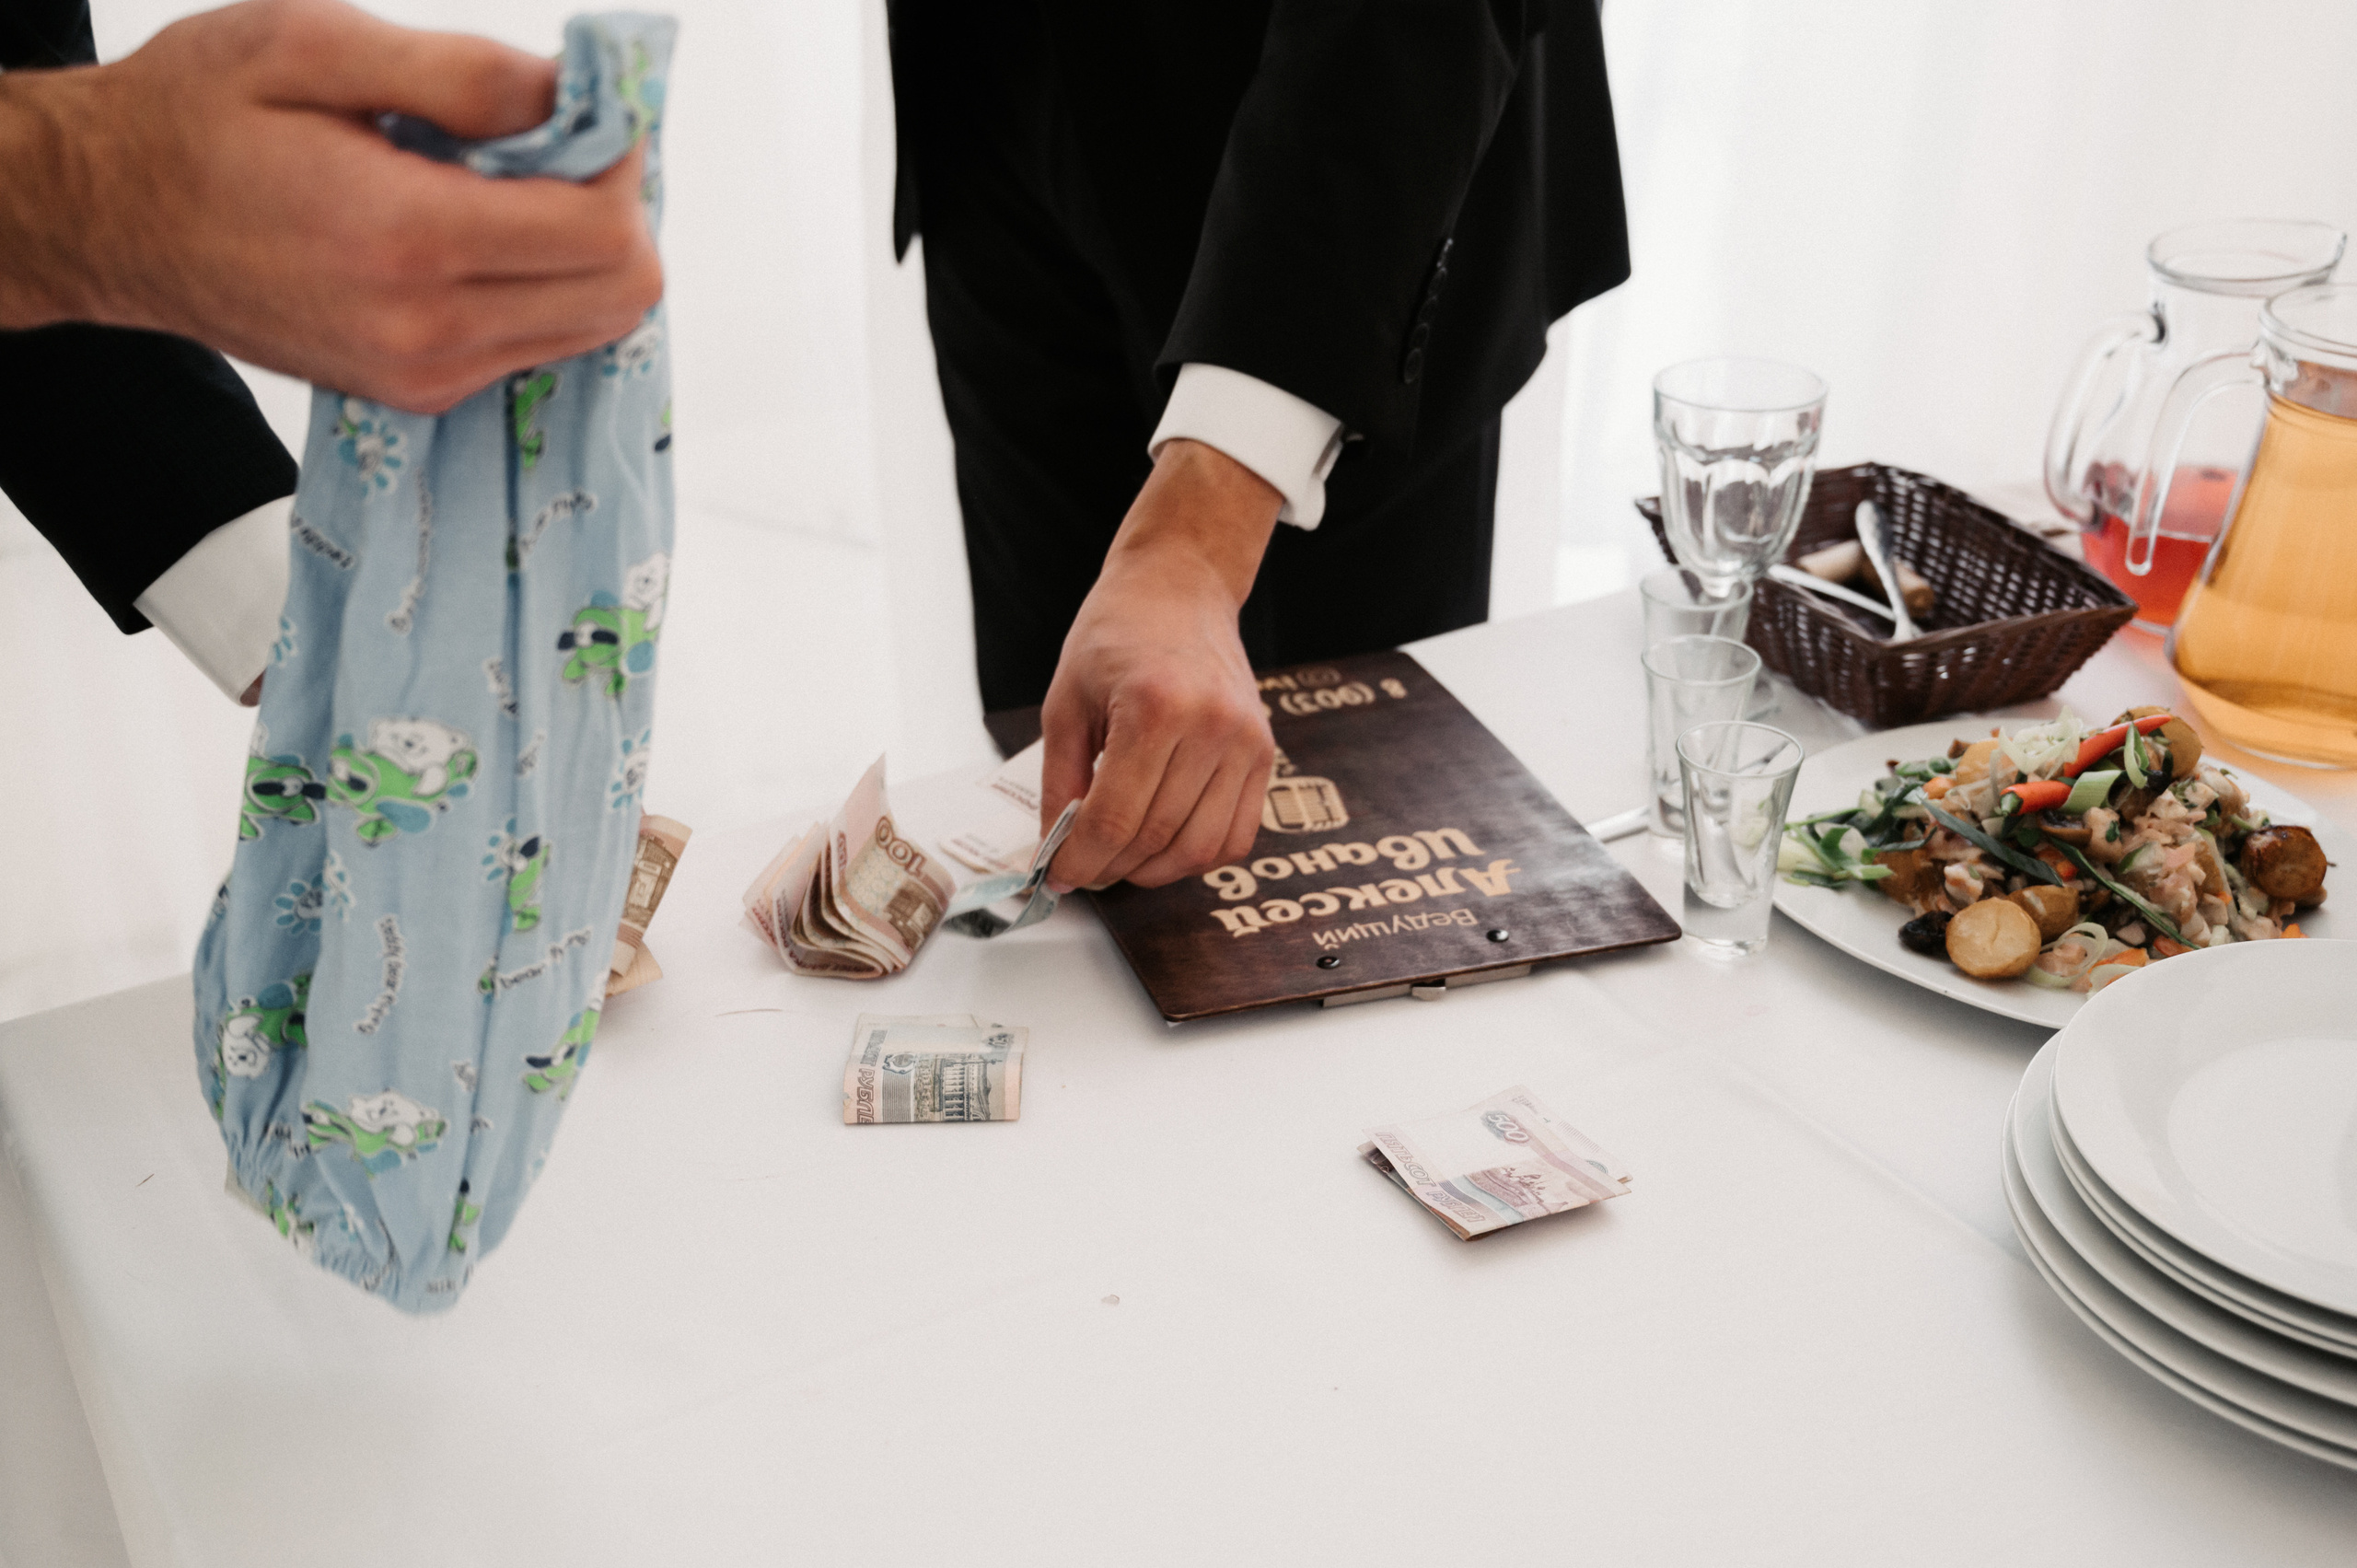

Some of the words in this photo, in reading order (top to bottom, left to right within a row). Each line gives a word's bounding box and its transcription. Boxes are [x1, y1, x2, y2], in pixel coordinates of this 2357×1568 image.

[876, 815, 927, 876] 100
[1202, 828, 1486, 901] Иванов
[1210, 859, 1521, 937] Алексей
[1313, 908, 1479, 950] Ведущий
[1486, 1112, 1530, 1145] 500
[1375, 1132, 1437, 1188] ПЯТЬСОТ
